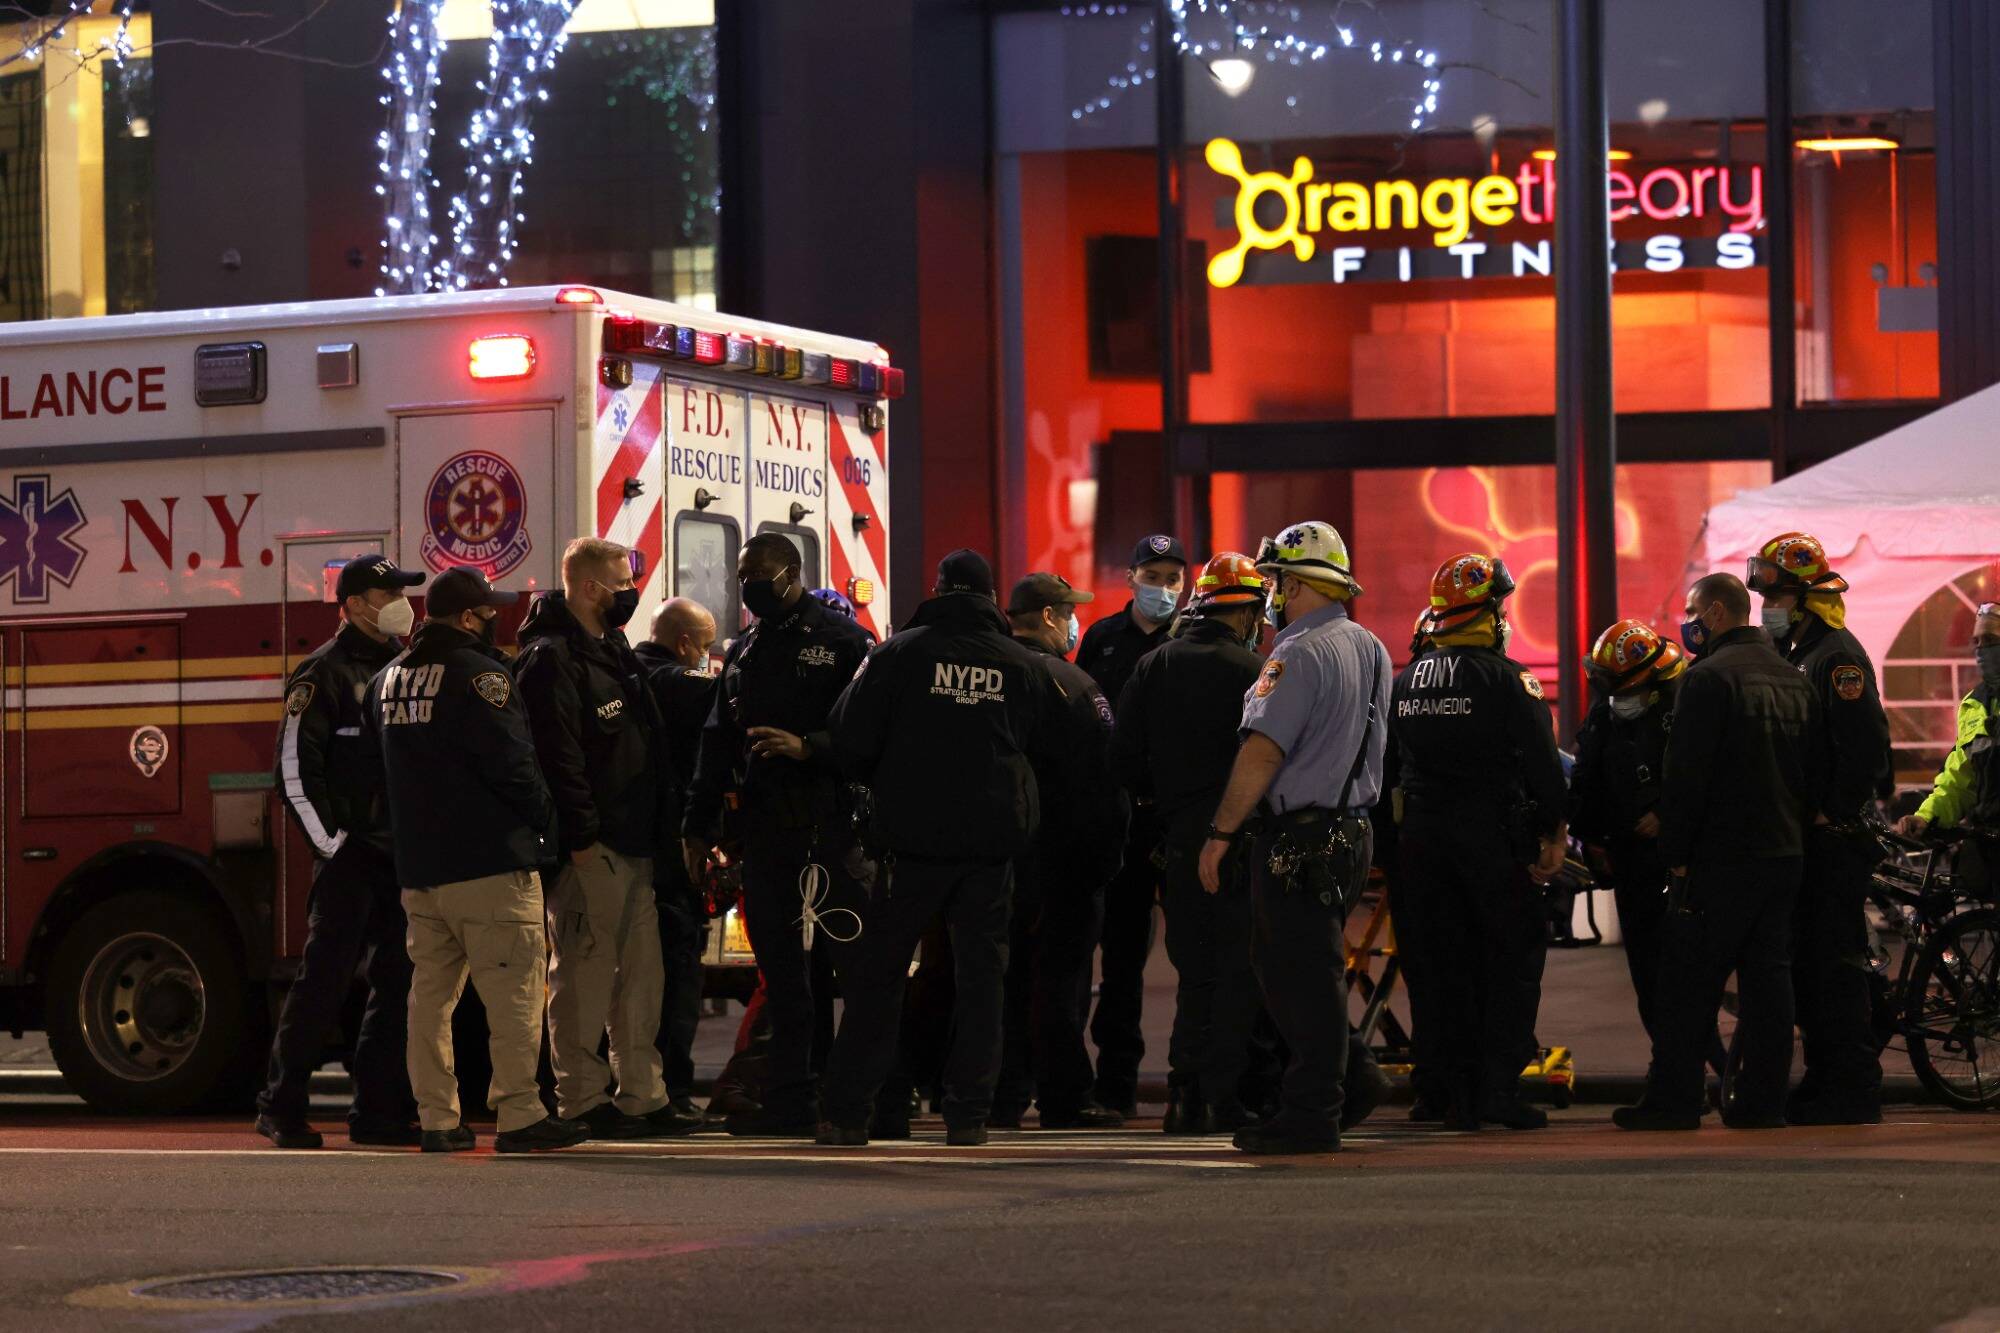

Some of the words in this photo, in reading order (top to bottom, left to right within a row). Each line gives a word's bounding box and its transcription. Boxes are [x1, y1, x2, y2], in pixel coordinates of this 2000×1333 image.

[1332, 232, 1756, 283] FITNSS
[0, 366, 167, 420] LANCE
[682, 387, 730, 438] F.D.
[767, 402, 812, 452] N.Y.
[444, 457, 508, 484] RESCUE
[671, 446, 741, 485] RESCUE
[755, 459, 823, 498] MEDICS
[843, 454, 871, 486] 006
[118, 493, 274, 574] N.Y.
[450, 537, 502, 559] MEDIC
[800, 648, 836, 661] POLICE
[381, 663, 446, 701] NYPD
[935, 662, 1004, 693] NYPD
[1410, 655, 1462, 689] FDNY
[597, 699, 623, 718] NYPD
[930, 686, 968, 698] STRATEGIC
[969, 690, 1005, 702] RESPONSE
[955, 697, 980, 705] GROUP
[1398, 698, 1472, 718] PARAMEDIC
[382, 700, 434, 726] TARU
